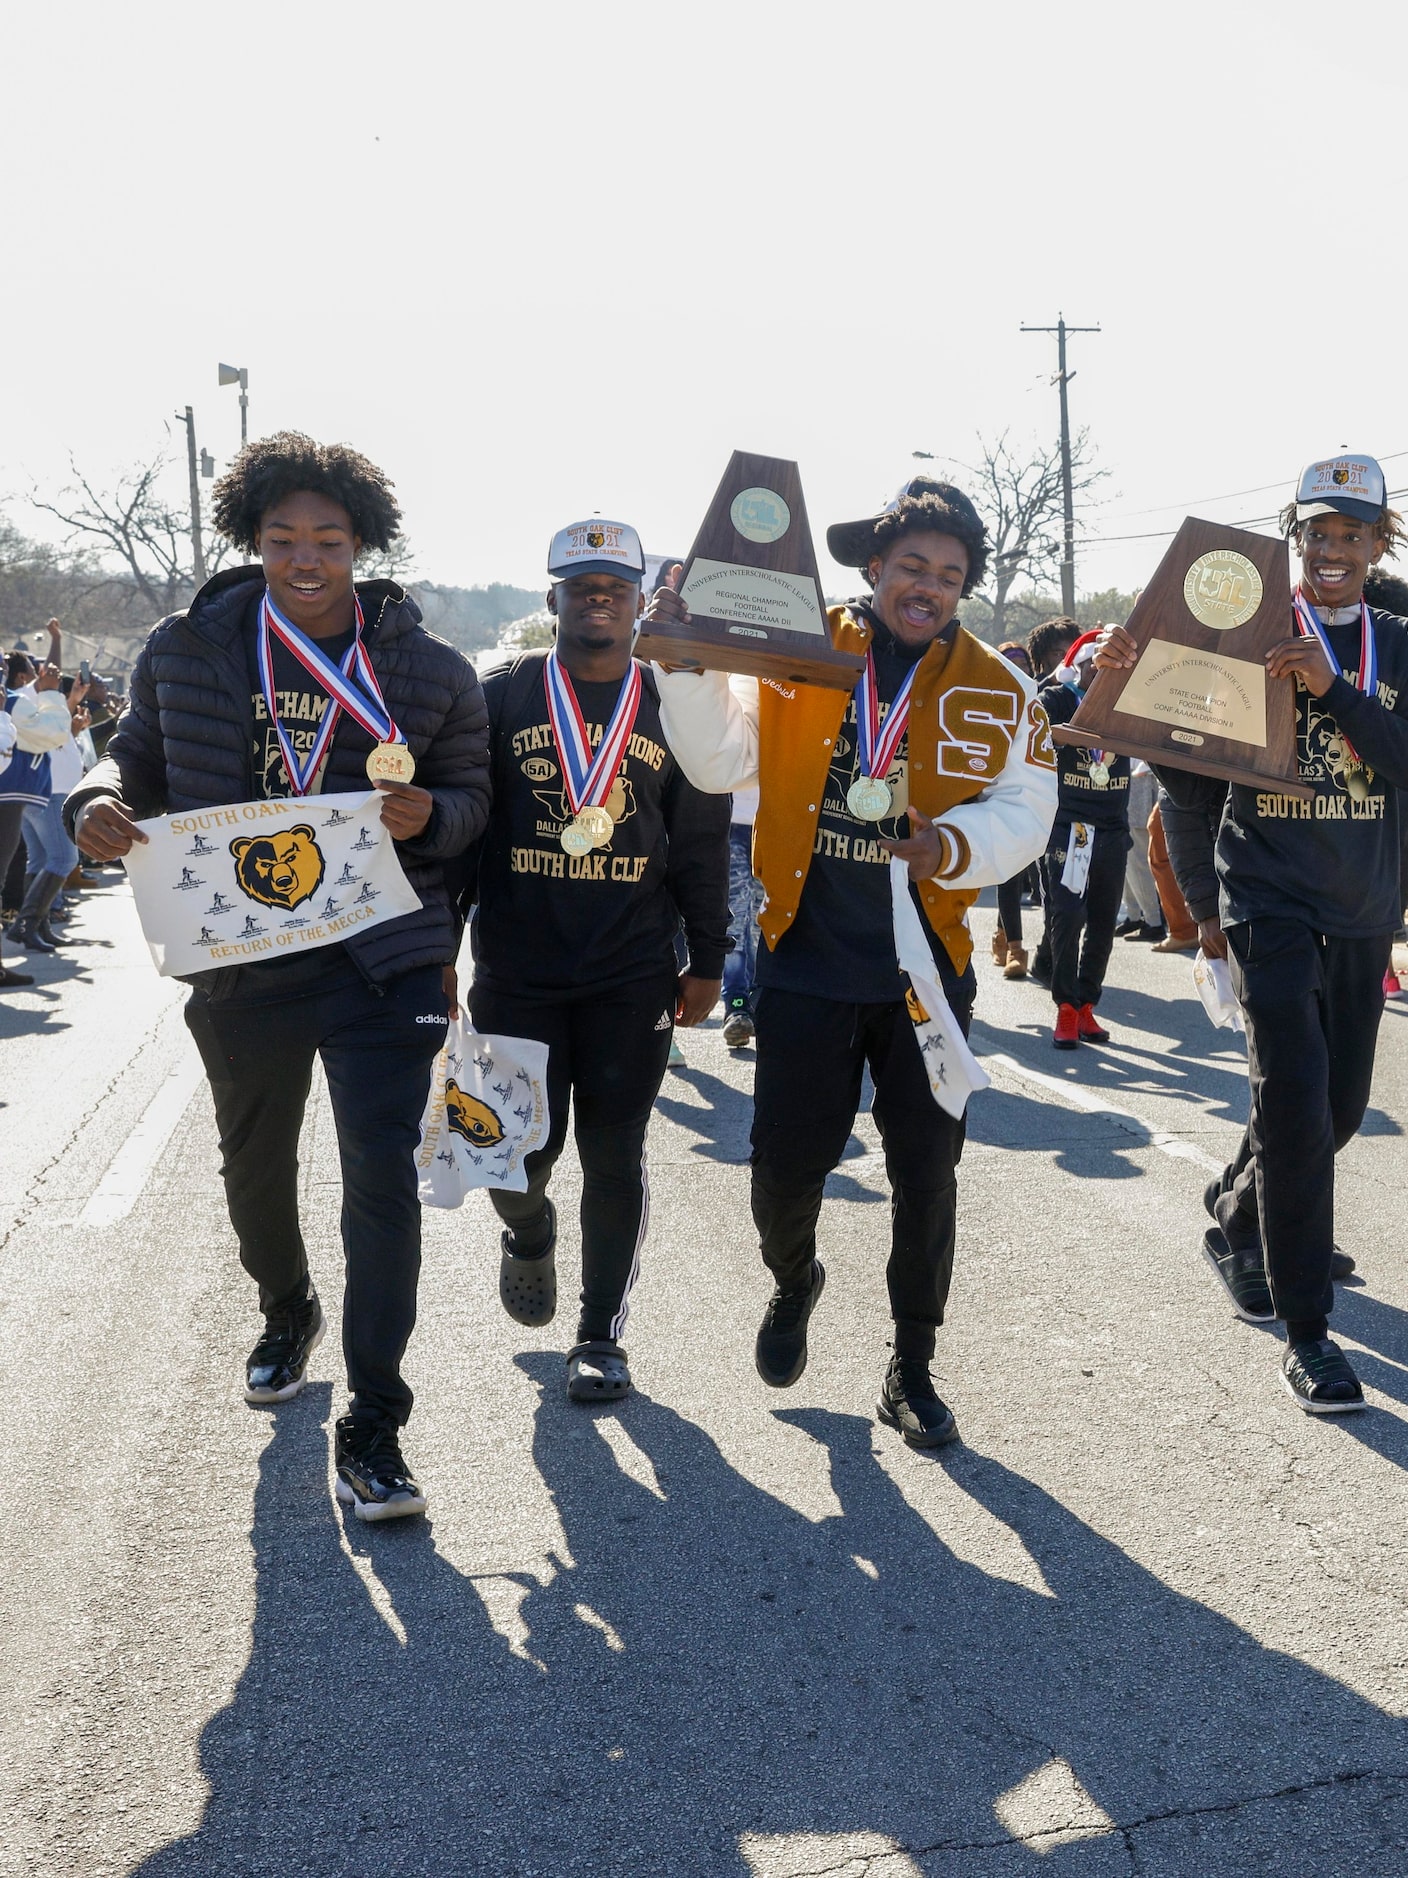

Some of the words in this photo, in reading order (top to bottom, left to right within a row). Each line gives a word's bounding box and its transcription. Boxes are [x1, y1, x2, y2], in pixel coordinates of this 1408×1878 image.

[1318, 471, 1331, 483] 20
[1350, 472, 1362, 484] 21
[567, 526, 587, 536] SOUTH
[572, 536, 585, 547] 20
[606, 534, 620, 547] 21
[687, 570, 728, 592] UNIVERSITY
[730, 570, 792, 592] INTERSCHOLASTIC
[792, 588, 816, 613] LEAGUE
[716, 590, 750, 602] REGIONAL
[752, 596, 788, 608] CHAMPION
[710, 606, 756, 620] CONFERENCE
[758, 614, 780, 624] AAAAA
[734, 602, 768, 614] FOOTBALL
[1204, 598, 1235, 614] STATE
[738, 628, 759, 638] 2021
[1144, 662, 1180, 686] UNIVERSITY
[1182, 660, 1239, 686] INTERSCHOLASTIC
[1236, 684, 1252, 710] LEAGUE
[1170, 688, 1190, 698] STATE
[1190, 693, 1228, 708] CHAMPION
[1178, 700, 1213, 714] FOOTBALL
[1154, 703, 1174, 712] CONF
[1174, 709, 1198, 719] AAAAA
[1200, 714, 1229, 726] DIVISION
[512, 724, 556, 757] STAT
[937, 686, 1017, 783] S
[1178, 734, 1196, 743] 2021
[529, 764, 546, 776] 5A
[1064, 773, 1090, 790] SOUTH
[1110, 776, 1130, 790] CLIFF
[824, 798, 849, 814] DALL
[1256, 794, 1312, 820] SOUTH
[1316, 795, 1347, 820] OAK
[170, 806, 239, 835] SOUTH
[242, 802, 289, 822] OAK
[511, 847, 564, 878] SOUTH
[569, 855, 607, 880] OAK
[210, 932, 273, 958] RETURN
[276, 932, 295, 946] OF
[296, 924, 327, 942] THE
[328, 904, 377, 933] MECCA
[416, 1014, 448, 1024] adidas
[654, 1020, 672, 1031] adidas
[427, 1092, 446, 1122] OAK
[417, 1126, 441, 1168] SOUTH
